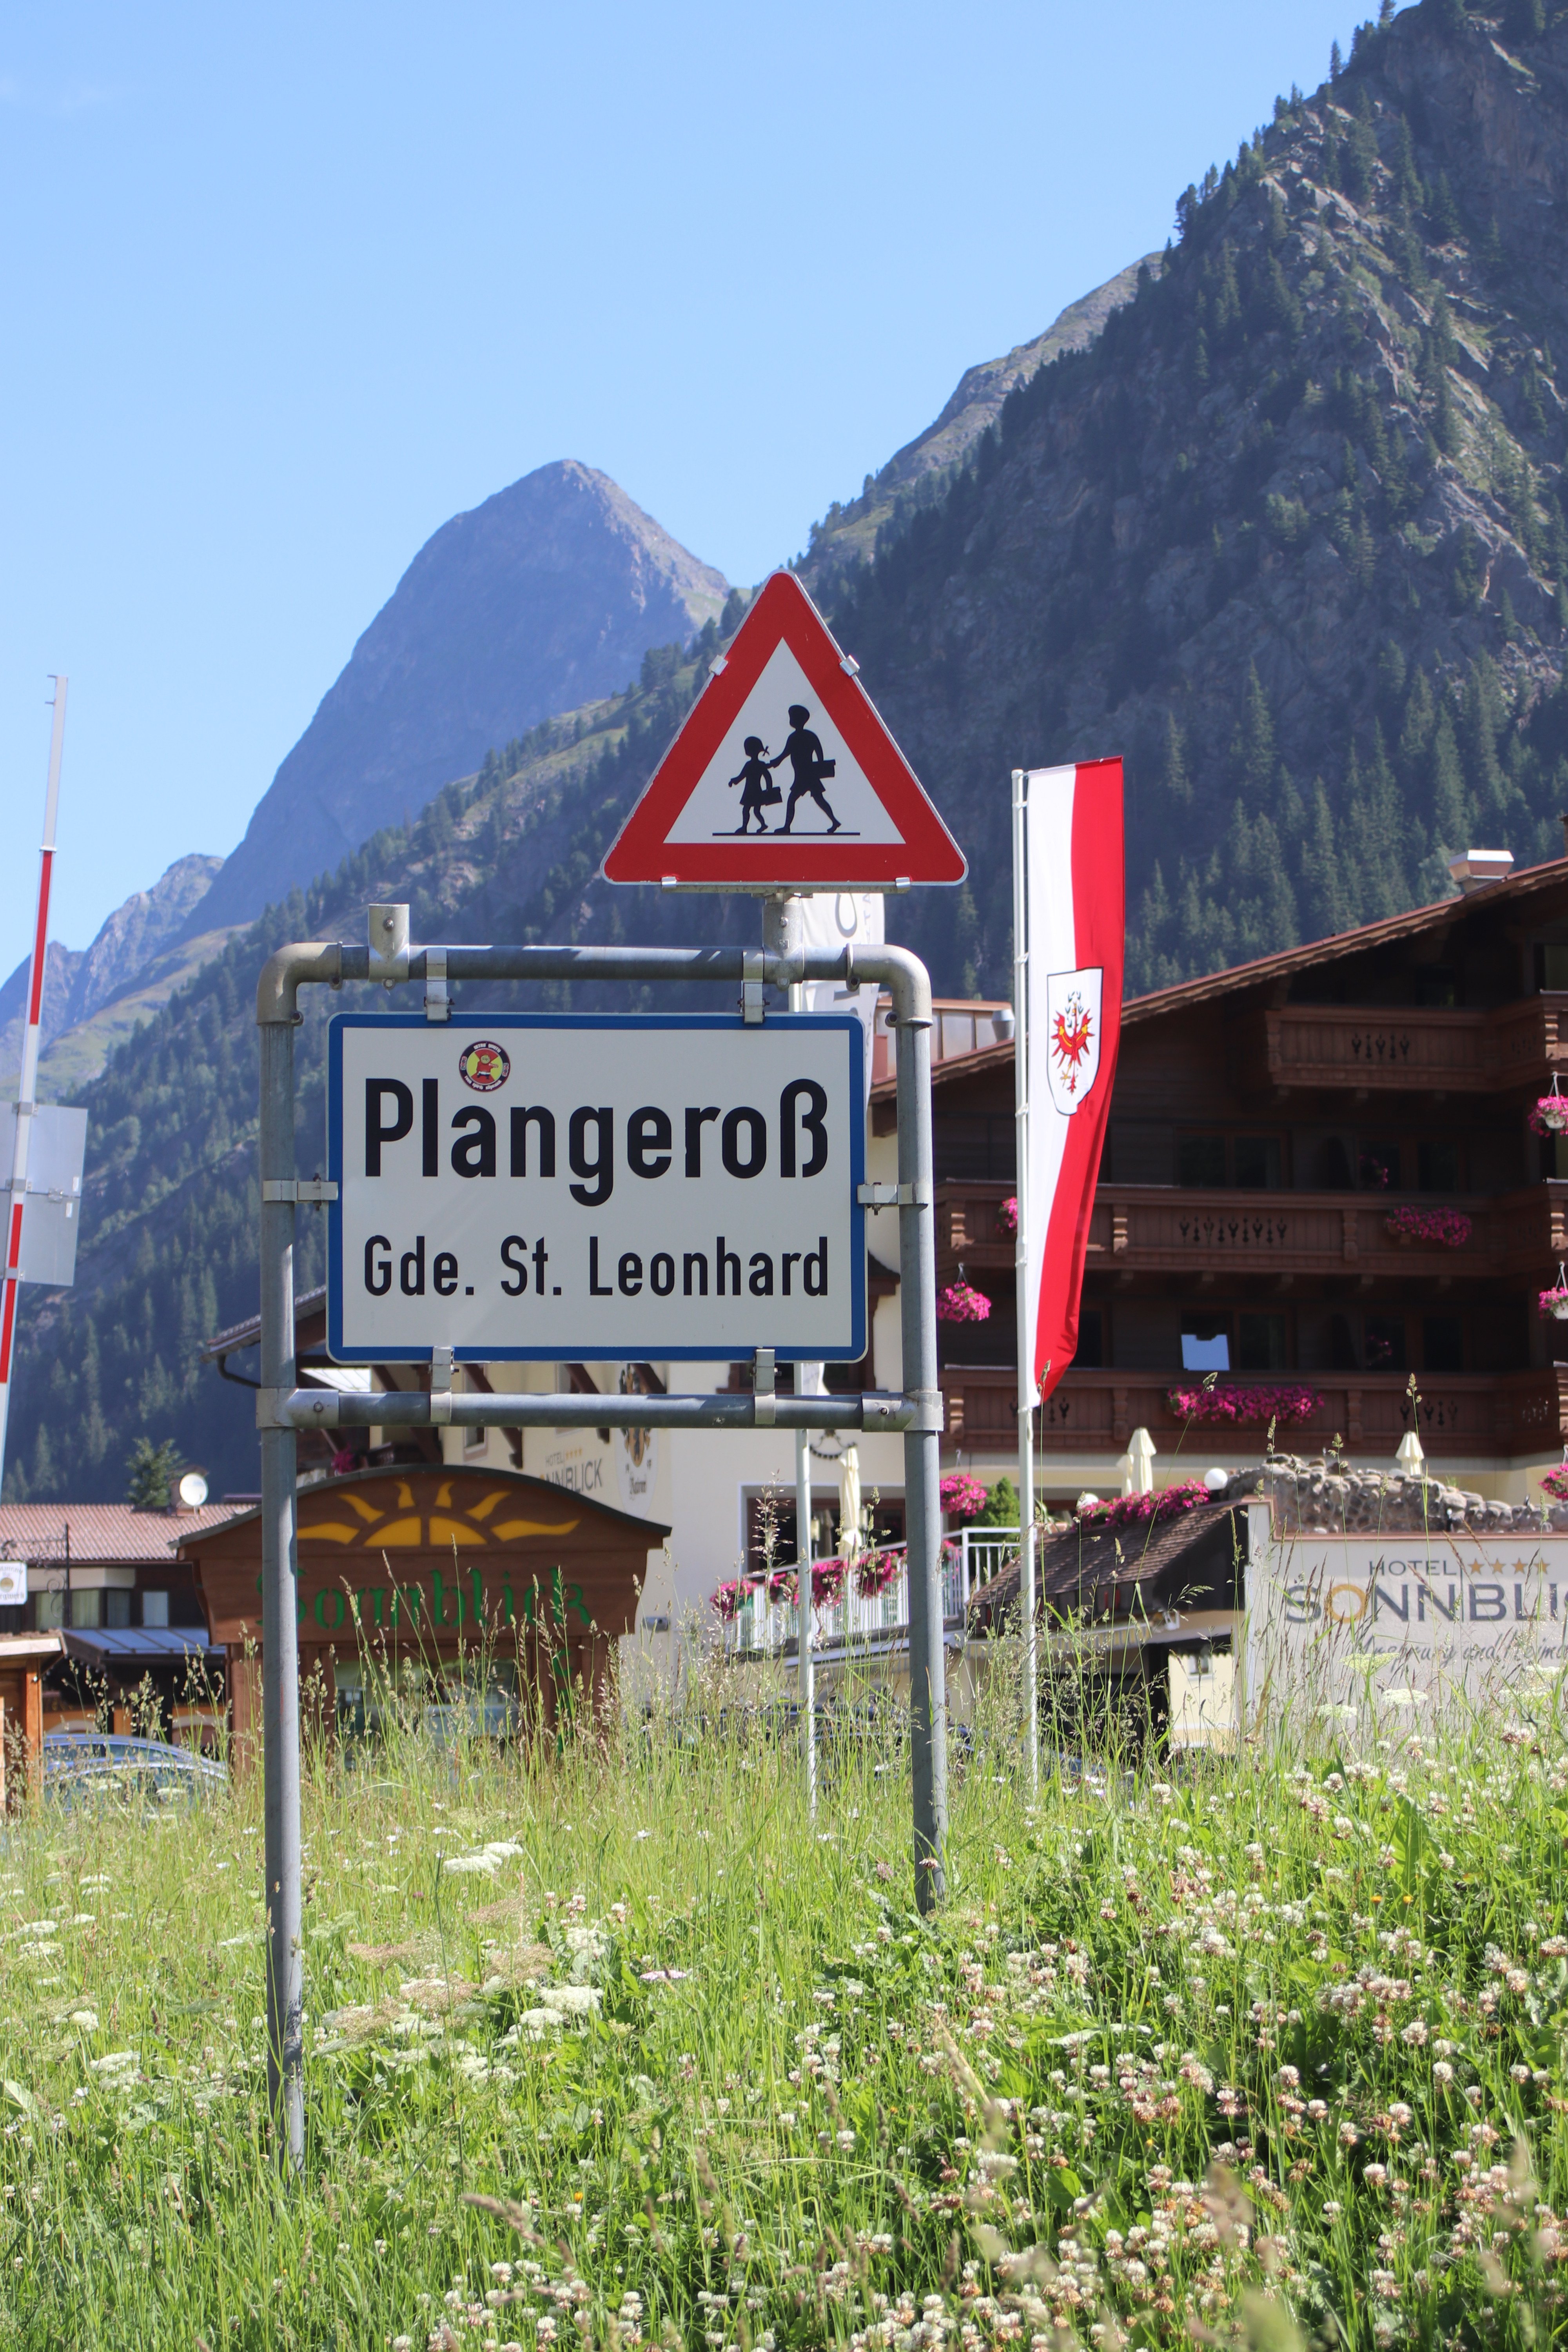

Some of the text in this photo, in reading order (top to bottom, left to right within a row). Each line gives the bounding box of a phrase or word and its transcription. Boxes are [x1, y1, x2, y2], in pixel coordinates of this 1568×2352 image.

[365, 1078, 828, 1207] Plangeroß
[365, 1235, 828, 1296] Gde. St. Leonhard
[545, 1452, 563, 1467] HOTEL
[1369, 1560, 1457, 1576] HOTEL
[1286, 1583, 1568, 1624] SONNBLI
